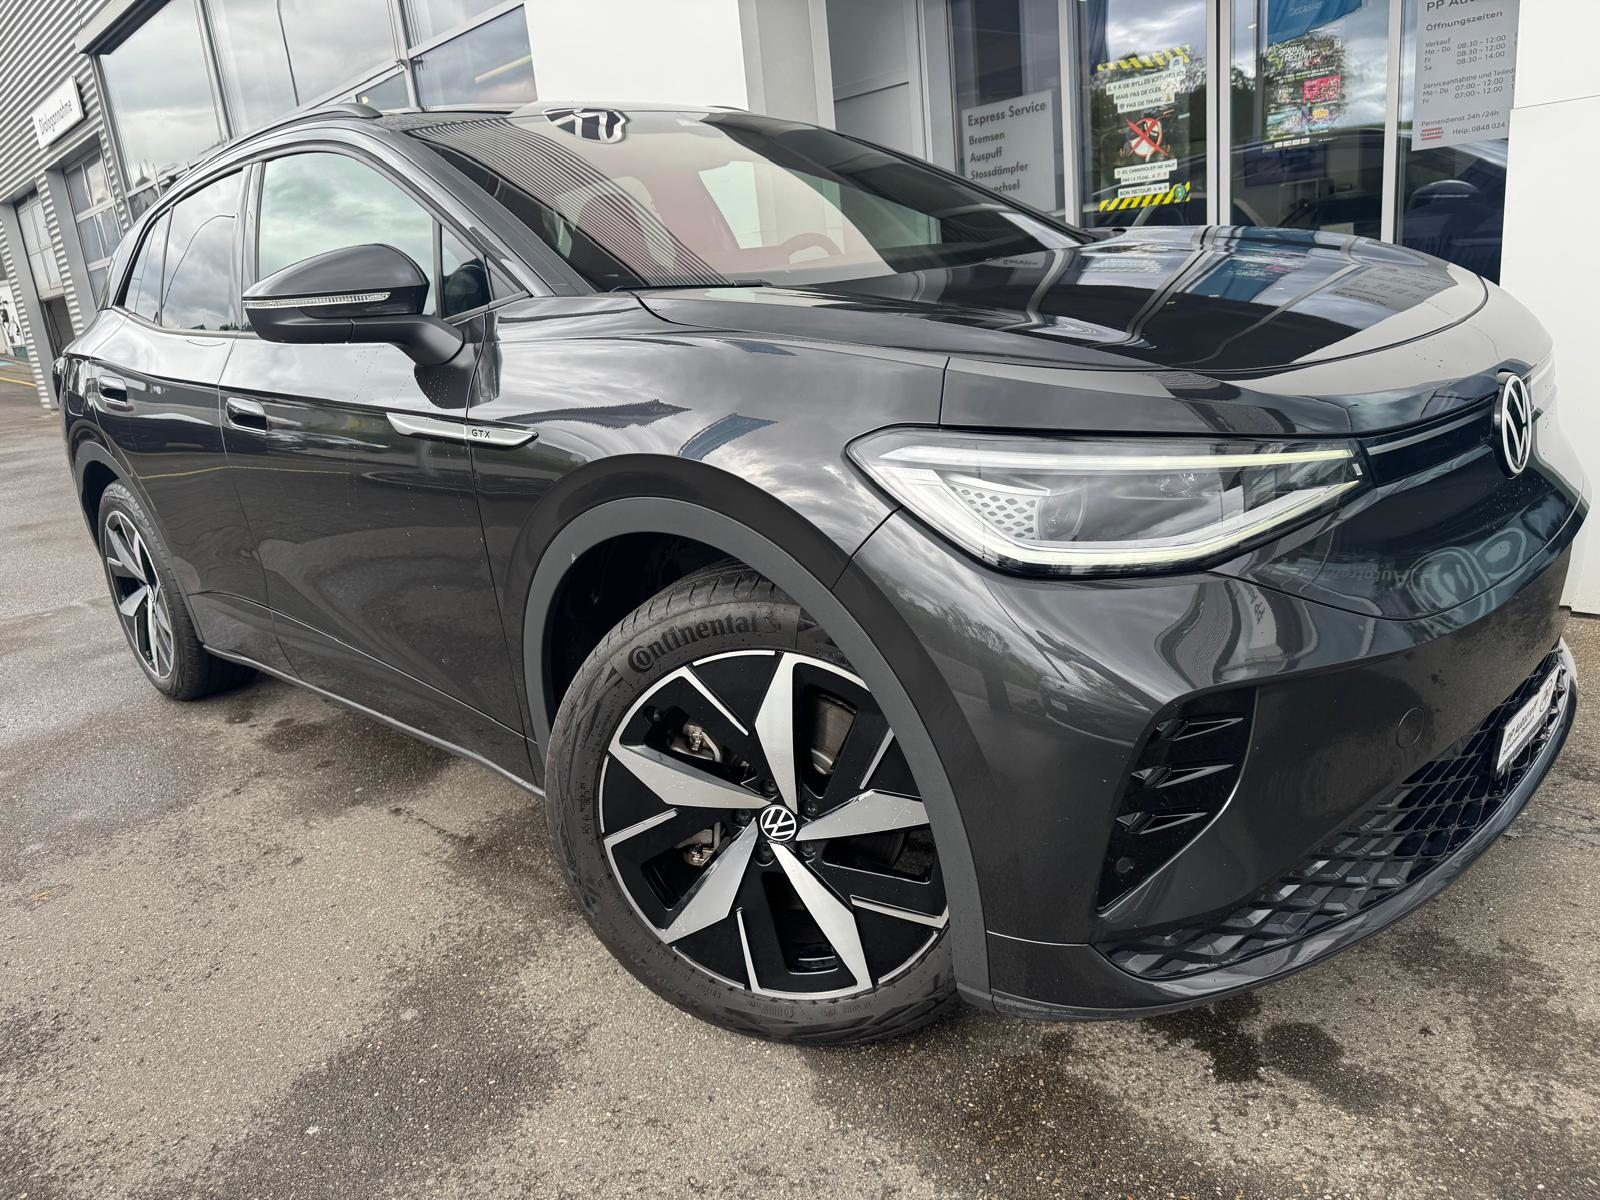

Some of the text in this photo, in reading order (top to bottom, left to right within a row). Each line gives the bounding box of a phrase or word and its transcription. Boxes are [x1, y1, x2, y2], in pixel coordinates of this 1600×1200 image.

[1426, 0, 1445, 12] PP
[1425, 37, 1451, 48] Verkauf
[1486, 35, 1506, 44] 12:00
[1278, 44, 1306, 57] SPRING
[1485, 43, 1506, 52] 12:00
[1283, 50, 1318, 62] FESTIVAL
[1485, 51, 1505, 60] 14:00
[1423, 74, 1477, 90] Serviceannahme
[1478, 72, 1492, 81] und
[1455, 82, 1476, 92] 07:00
[1483, 77, 1504, 86] 12:00
[1454, 90, 1475, 99] 07:00
[1483, 86, 1503, 95] 12:00
[967, 101, 1046, 127] Express Service
[1421, 115, 1465, 127] Pannendienst
[1491, 122, 1505, 130] 024
[969, 132, 1005, 146] Bremsen
[970, 146, 1002, 163] Auspuff
[970, 161, 1028, 180] Stossdämpfer
[991, 179, 1020, 193] echsel
[471, 429, 491, 439] GTX
[628, 611, 761, 674] Continental
